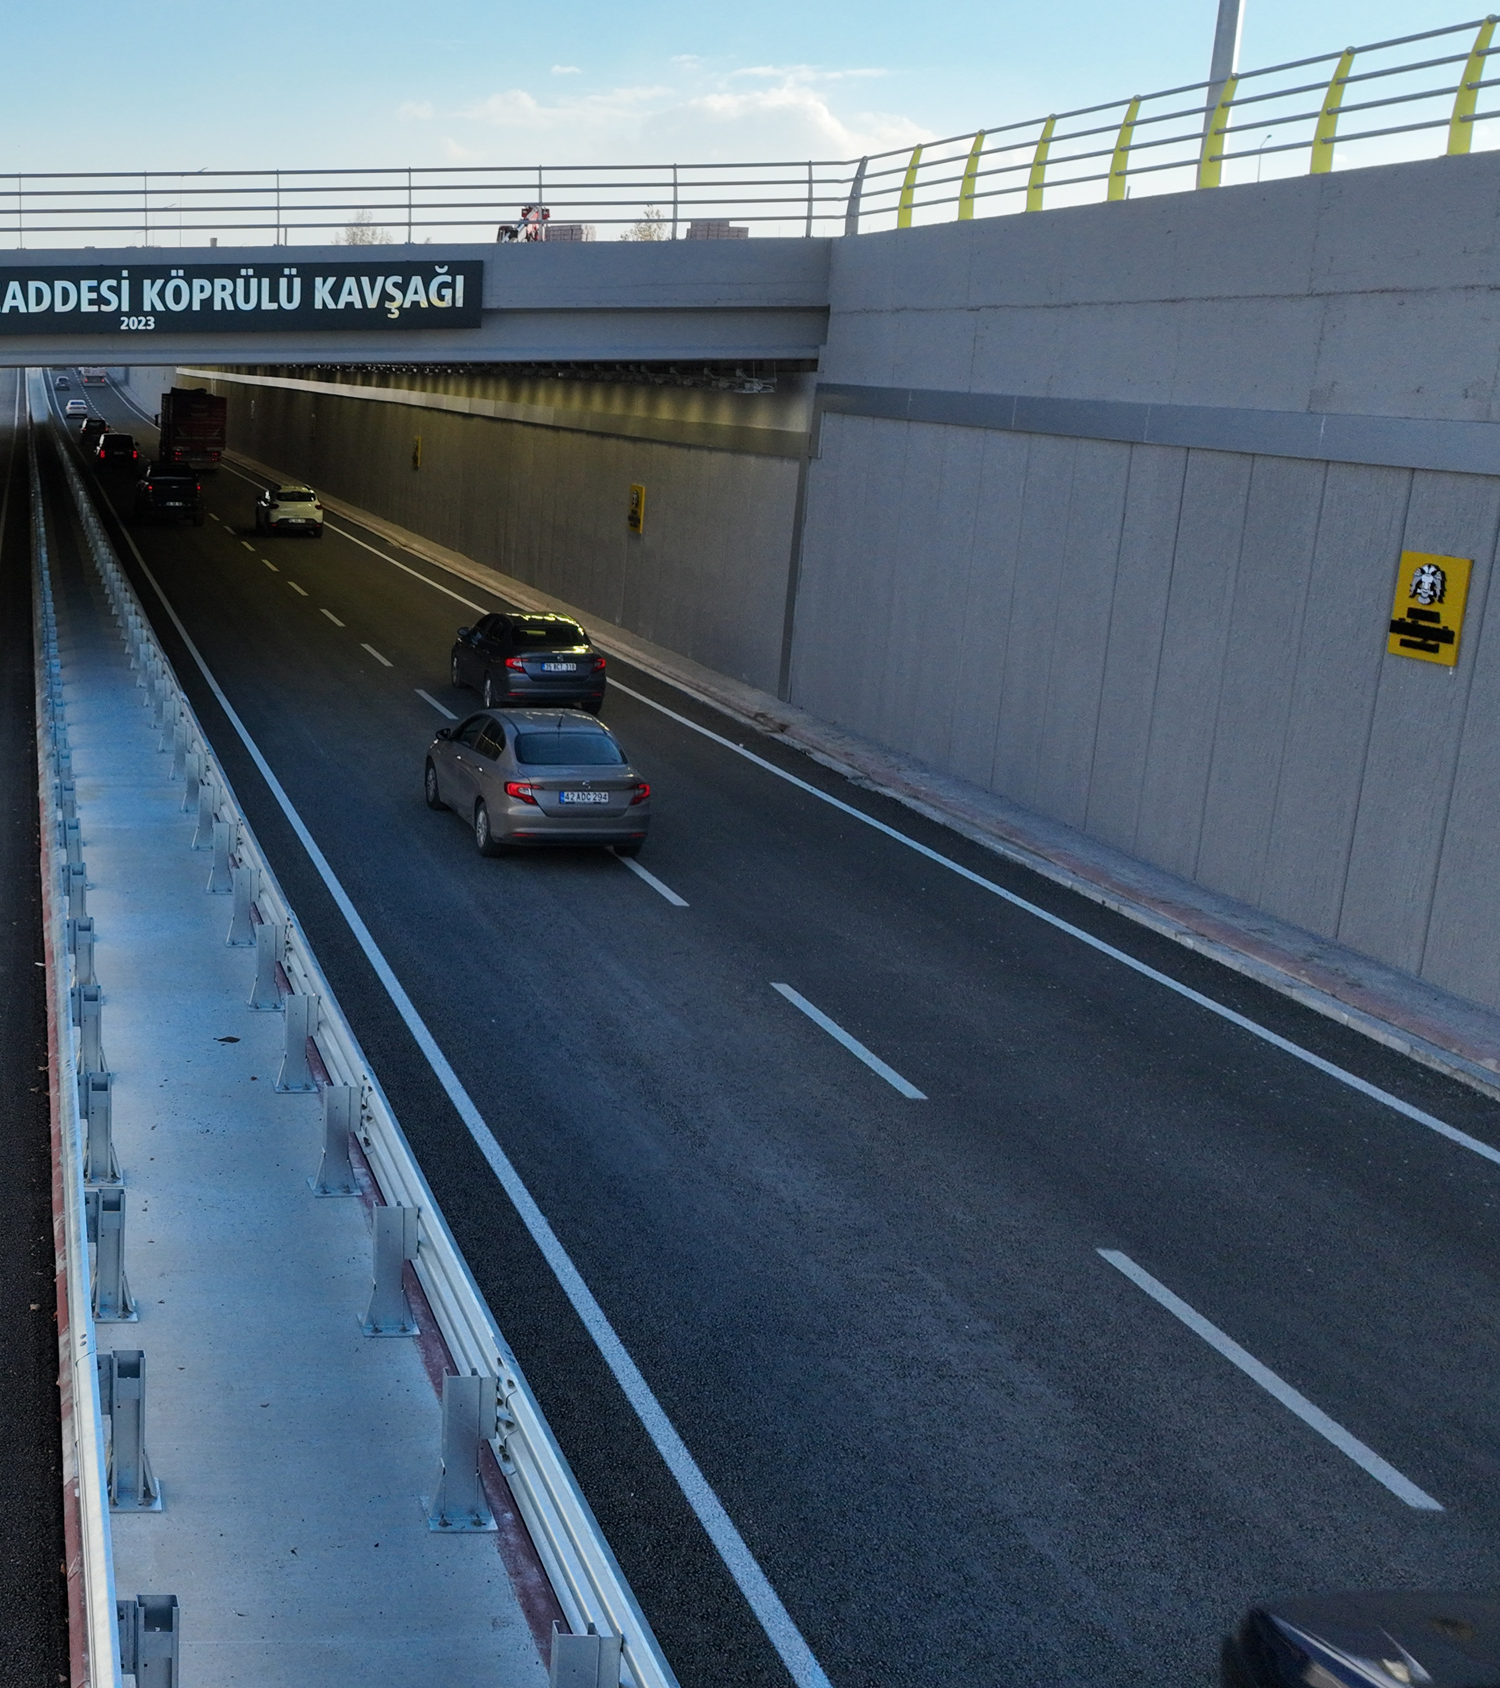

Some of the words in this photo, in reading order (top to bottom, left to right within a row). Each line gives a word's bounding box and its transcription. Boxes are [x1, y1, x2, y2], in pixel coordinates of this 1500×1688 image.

[143, 268, 300, 312] KÖPRÜLÜ
[314, 265, 464, 318] KAVŞAĞI
[120, 317, 155, 330] 2023
[564, 792, 575, 801] 42
[592, 792, 607, 801] 294
